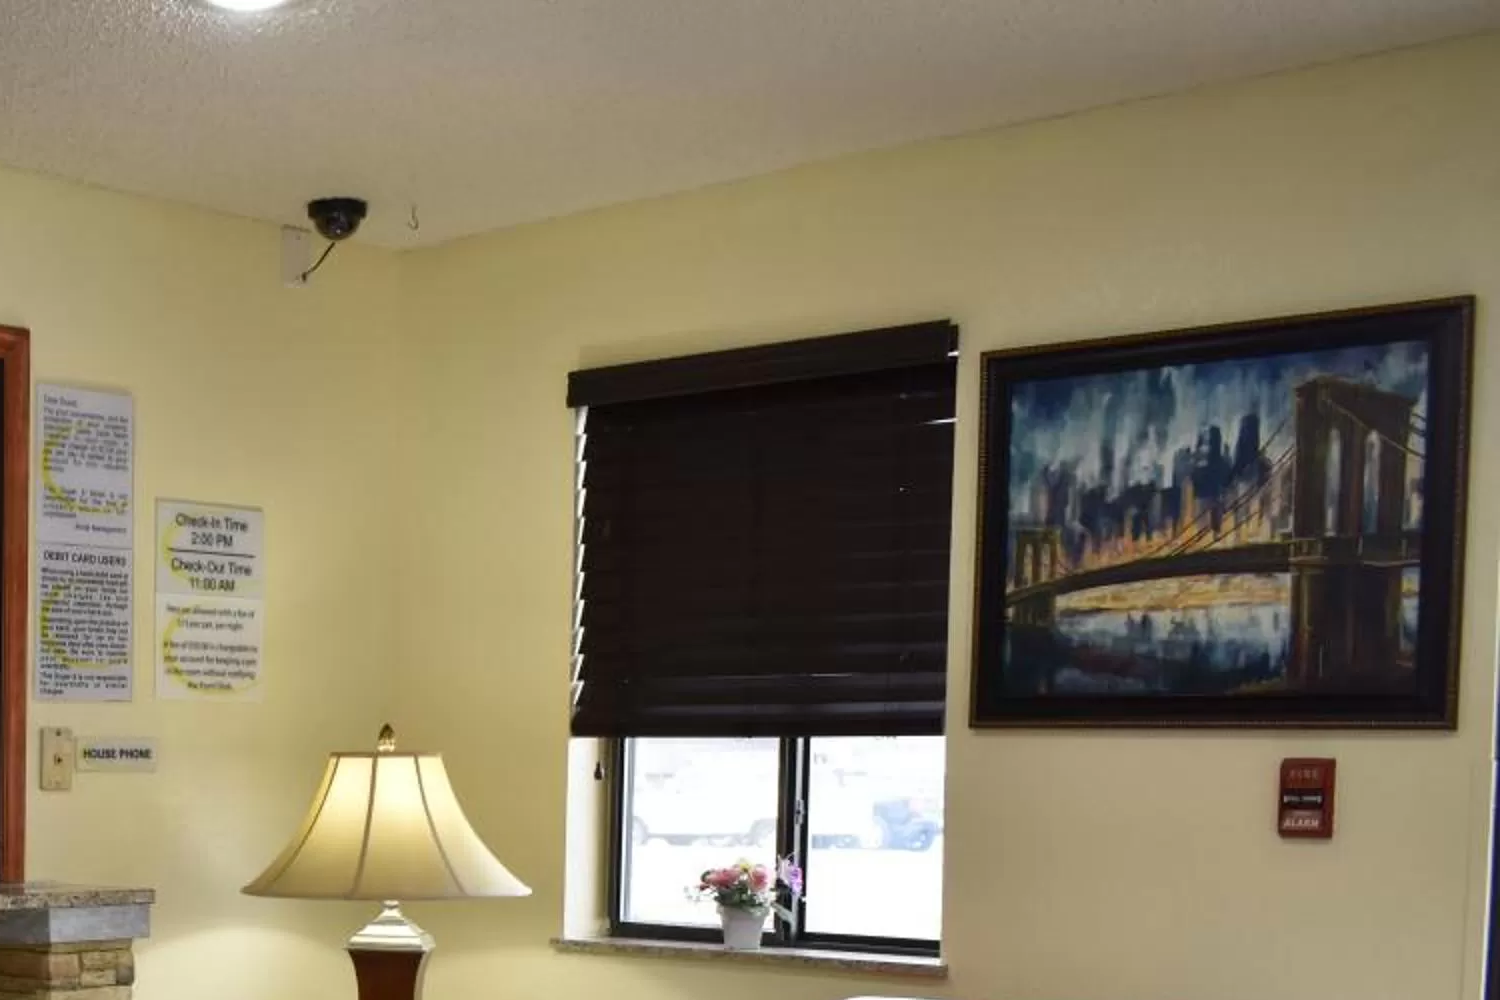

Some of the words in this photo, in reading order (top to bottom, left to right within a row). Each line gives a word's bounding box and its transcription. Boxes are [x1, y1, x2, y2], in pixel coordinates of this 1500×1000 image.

[224, 516, 248, 532] Time
[216, 533, 233, 548] PM
[71, 553, 97, 565] CARD
[227, 561, 252, 576] Time
[218, 578, 235, 592] AM
[83, 747, 117, 759] HOUSE
[119, 747, 152, 759] PHONE
